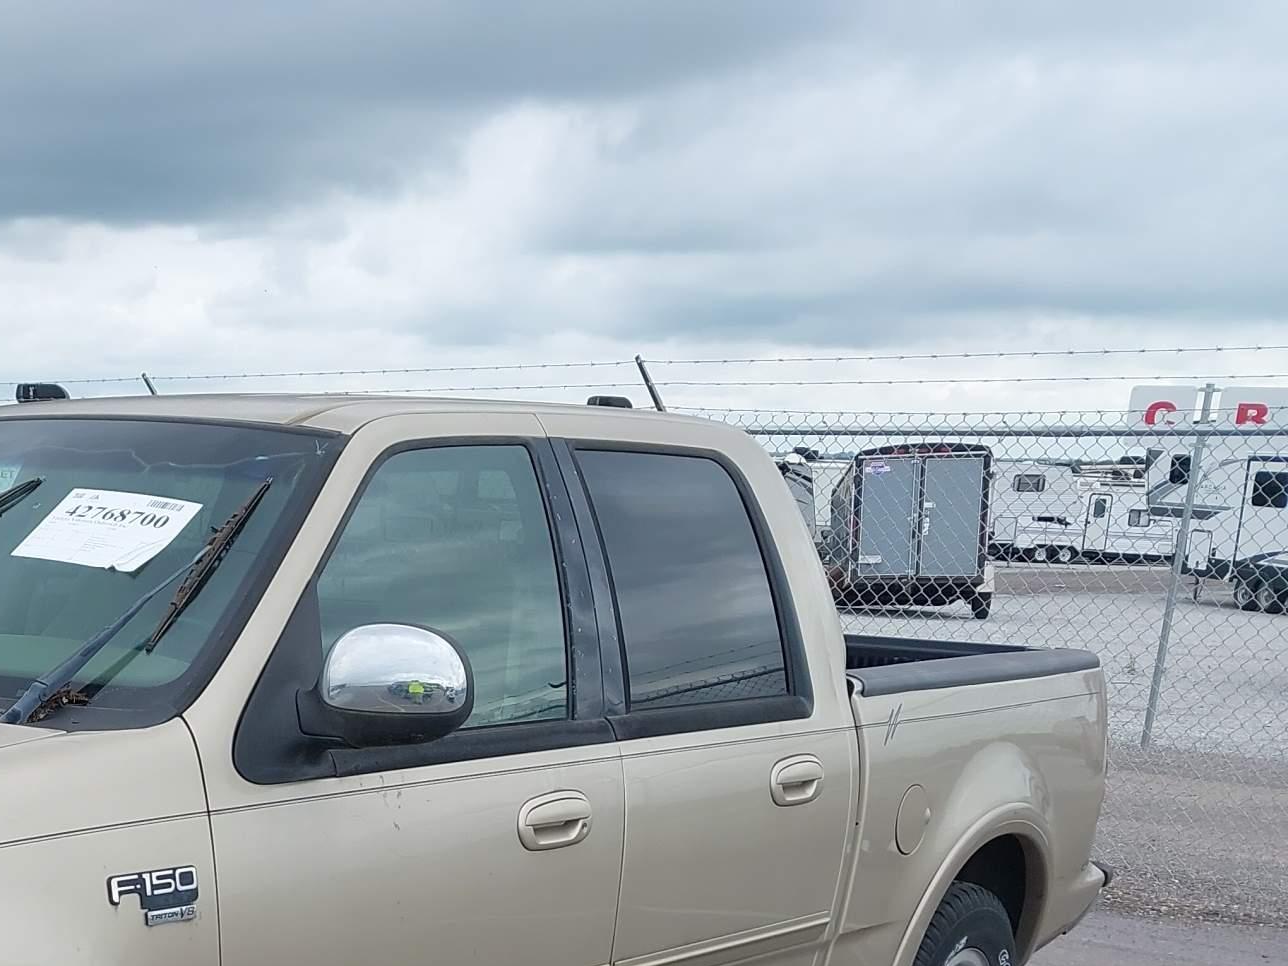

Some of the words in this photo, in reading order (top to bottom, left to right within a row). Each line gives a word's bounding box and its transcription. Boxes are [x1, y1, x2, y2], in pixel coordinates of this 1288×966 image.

[65, 504, 170, 529] 42768700
[110, 866, 198, 903] F-150
[150, 911, 179, 922] TRITON
[179, 906, 195, 919] V8
